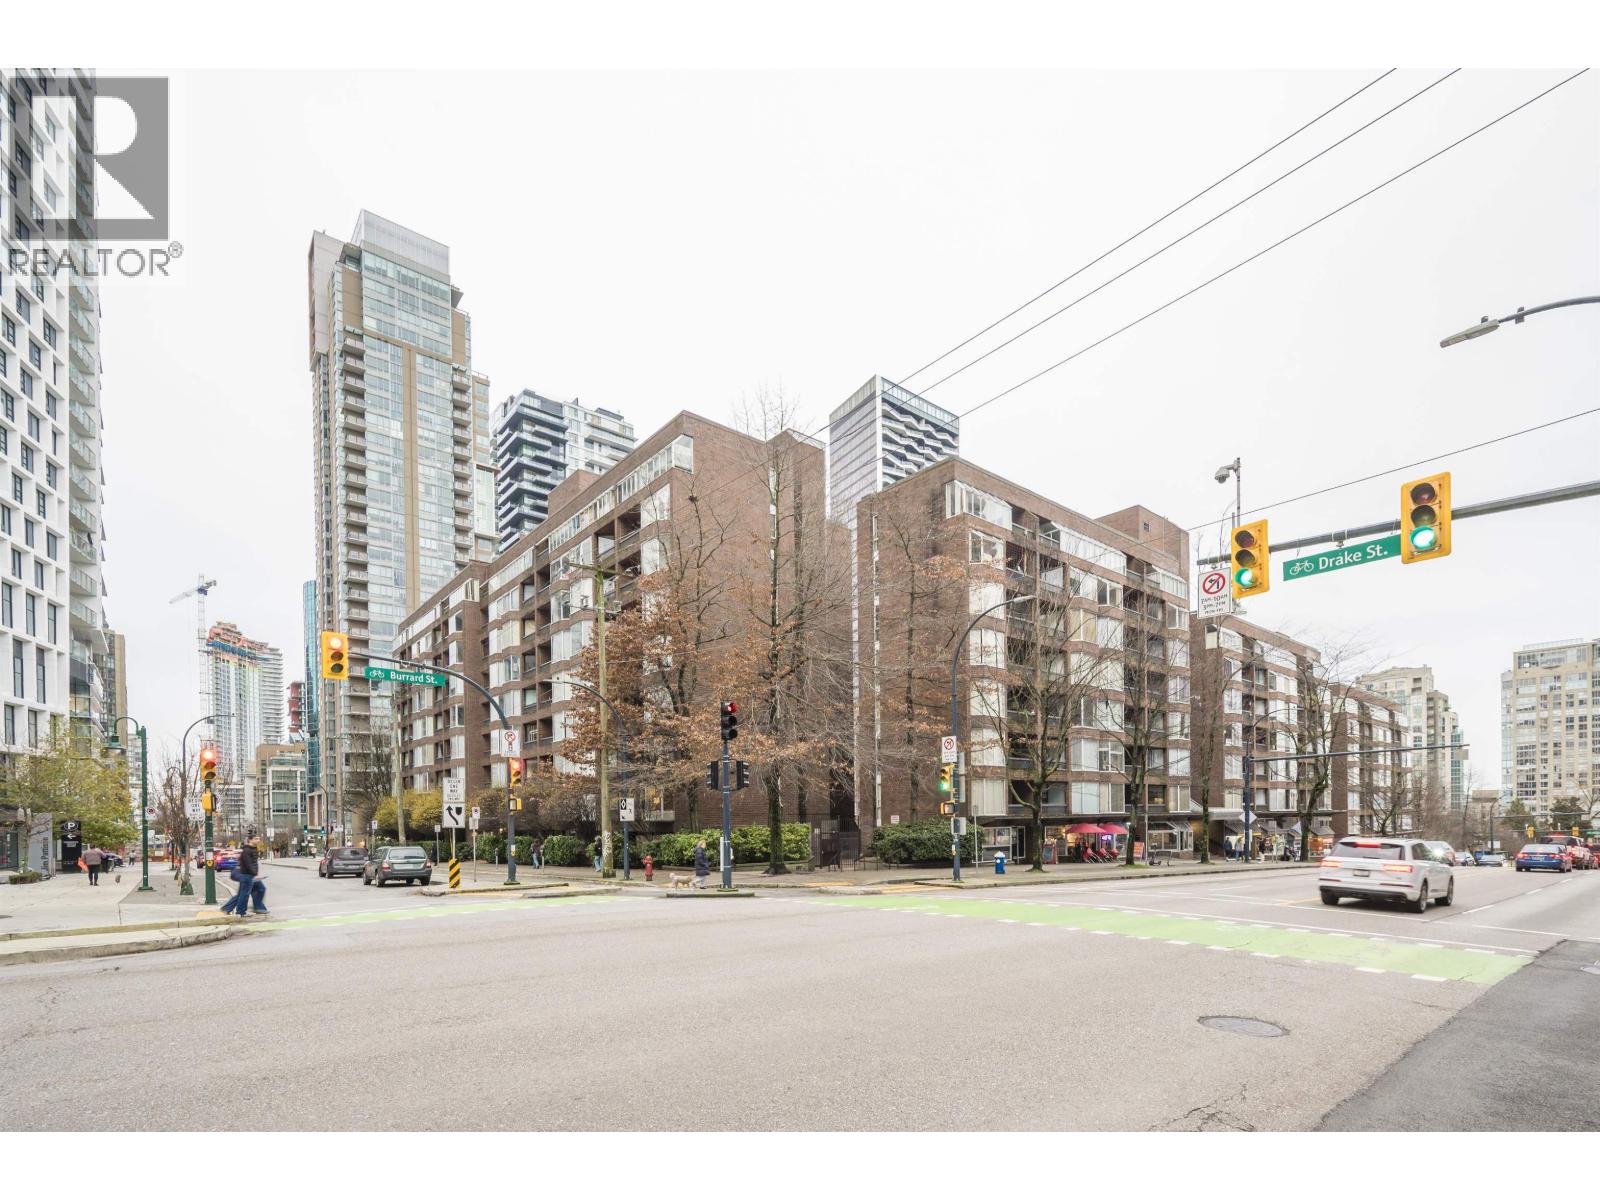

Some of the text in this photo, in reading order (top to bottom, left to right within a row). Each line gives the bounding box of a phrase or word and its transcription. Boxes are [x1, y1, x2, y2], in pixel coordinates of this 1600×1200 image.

[1318, 545, 1388, 569] Drake St.
[390, 671, 438, 684] Burrard St.
